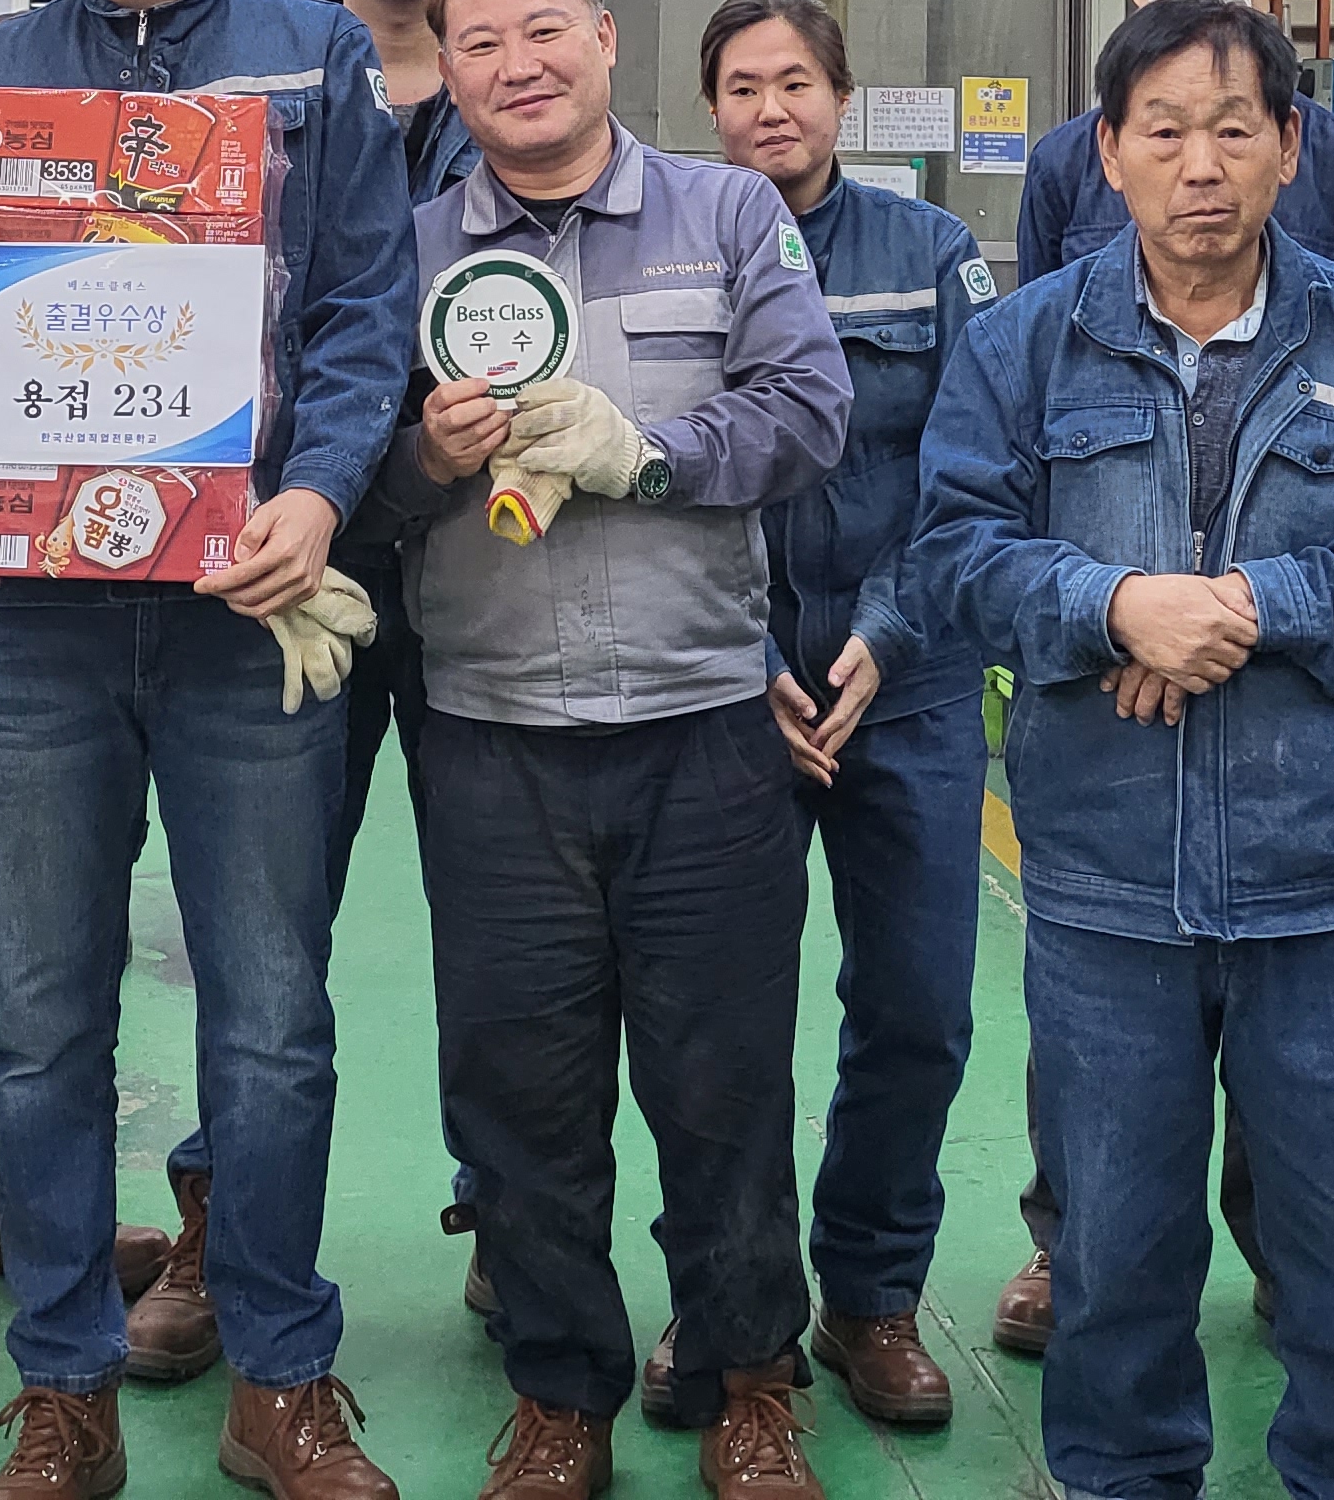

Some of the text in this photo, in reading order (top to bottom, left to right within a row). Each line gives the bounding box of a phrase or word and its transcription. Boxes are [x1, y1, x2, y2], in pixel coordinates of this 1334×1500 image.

[983, 101, 1007, 113] 호주
[4, 129, 54, 150] 농심
[119, 114, 171, 181] 辛
[43, 161, 93, 180] 3538
[148, 161, 180, 176] 라면
[67, 280, 147, 291] 베스트클래스
[45, 302, 167, 334] 출결우수상
[457, 303, 544, 322] Best Class
[435, 338, 447, 363] KOREA
[550, 333, 566, 370] INSTITUTE
[12, 378, 192, 421] 용접 234
[41, 433, 158, 444] 한국산업직업전문학교
